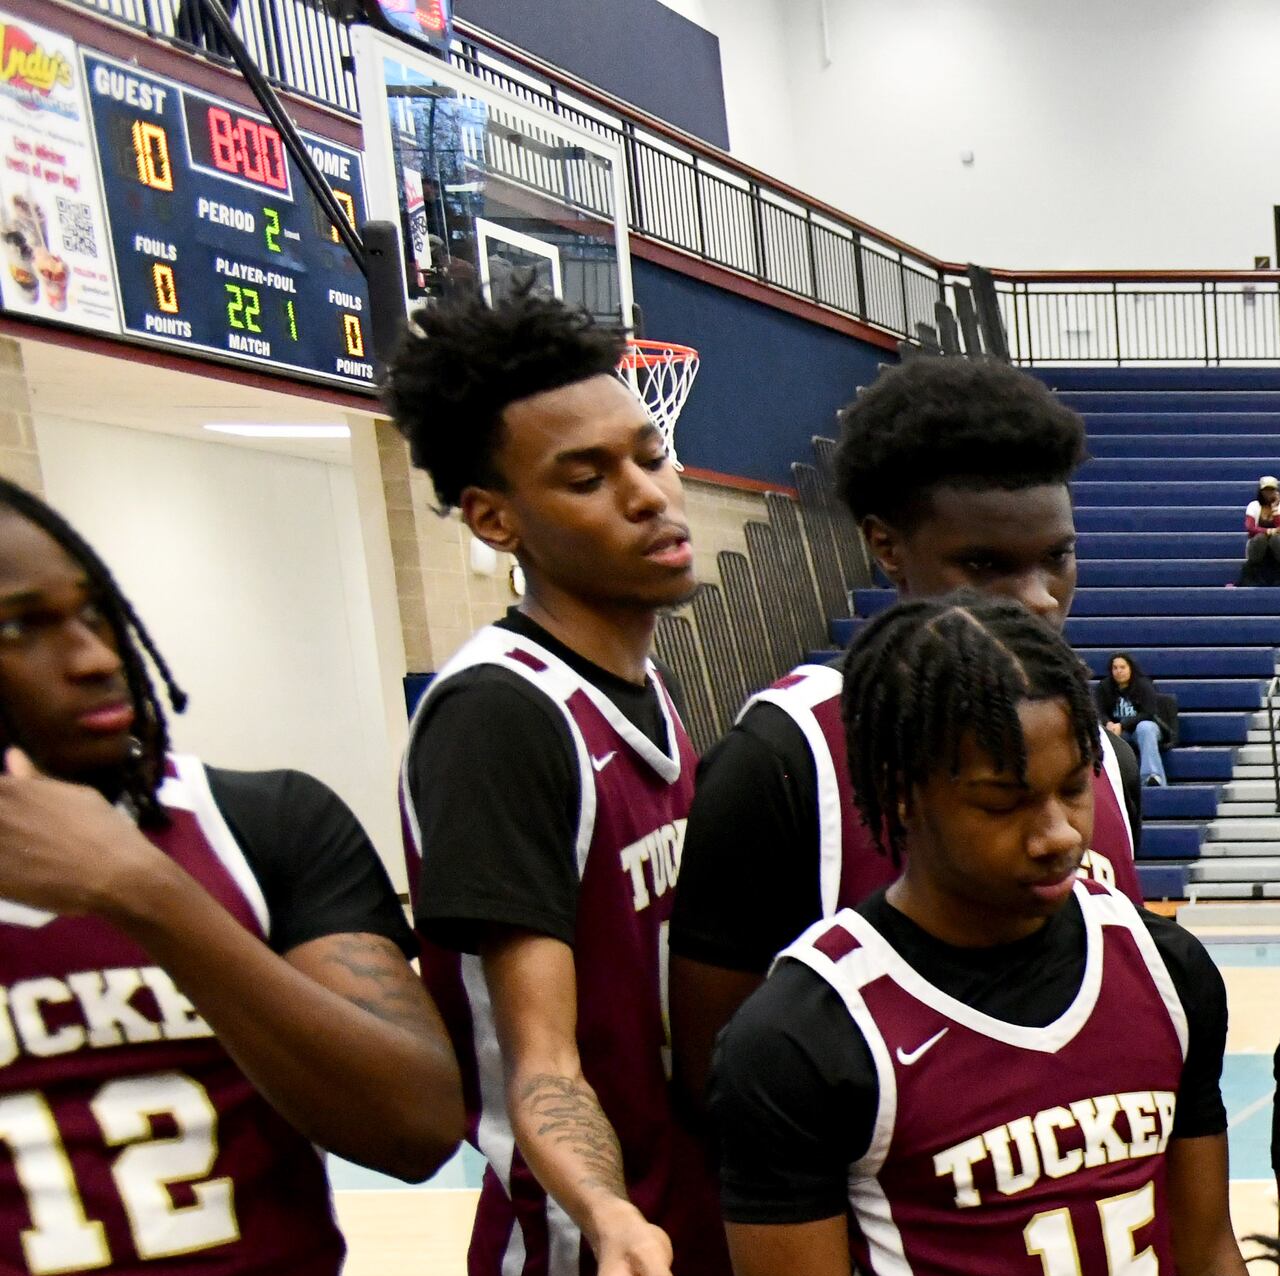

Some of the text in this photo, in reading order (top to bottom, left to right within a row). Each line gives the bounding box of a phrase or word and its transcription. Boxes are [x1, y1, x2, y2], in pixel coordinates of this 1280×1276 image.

[94, 66, 167, 114] GUEST
[132, 120, 174, 191] 10
[208, 106, 287, 190] 8:00
[307, 146, 351, 181] OME
[198, 198, 255, 233] PERIOD
[263, 207, 281, 252] 2
[135, 235, 177, 261] FOULS
[152, 261, 179, 314] 0
[216, 257, 297, 294] PLAYER-FOUL
[225, 284, 261, 333] 22
[329, 289, 362, 311] FOULS
[146, 314, 192, 339] POINTS
[229, 333, 271, 357] MATCH
[343, 313, 365, 358] 0
[337, 358, 374, 380] POINTS
[620, 818, 688, 912] TUC
[0, 1068, 240, 1276] 12
